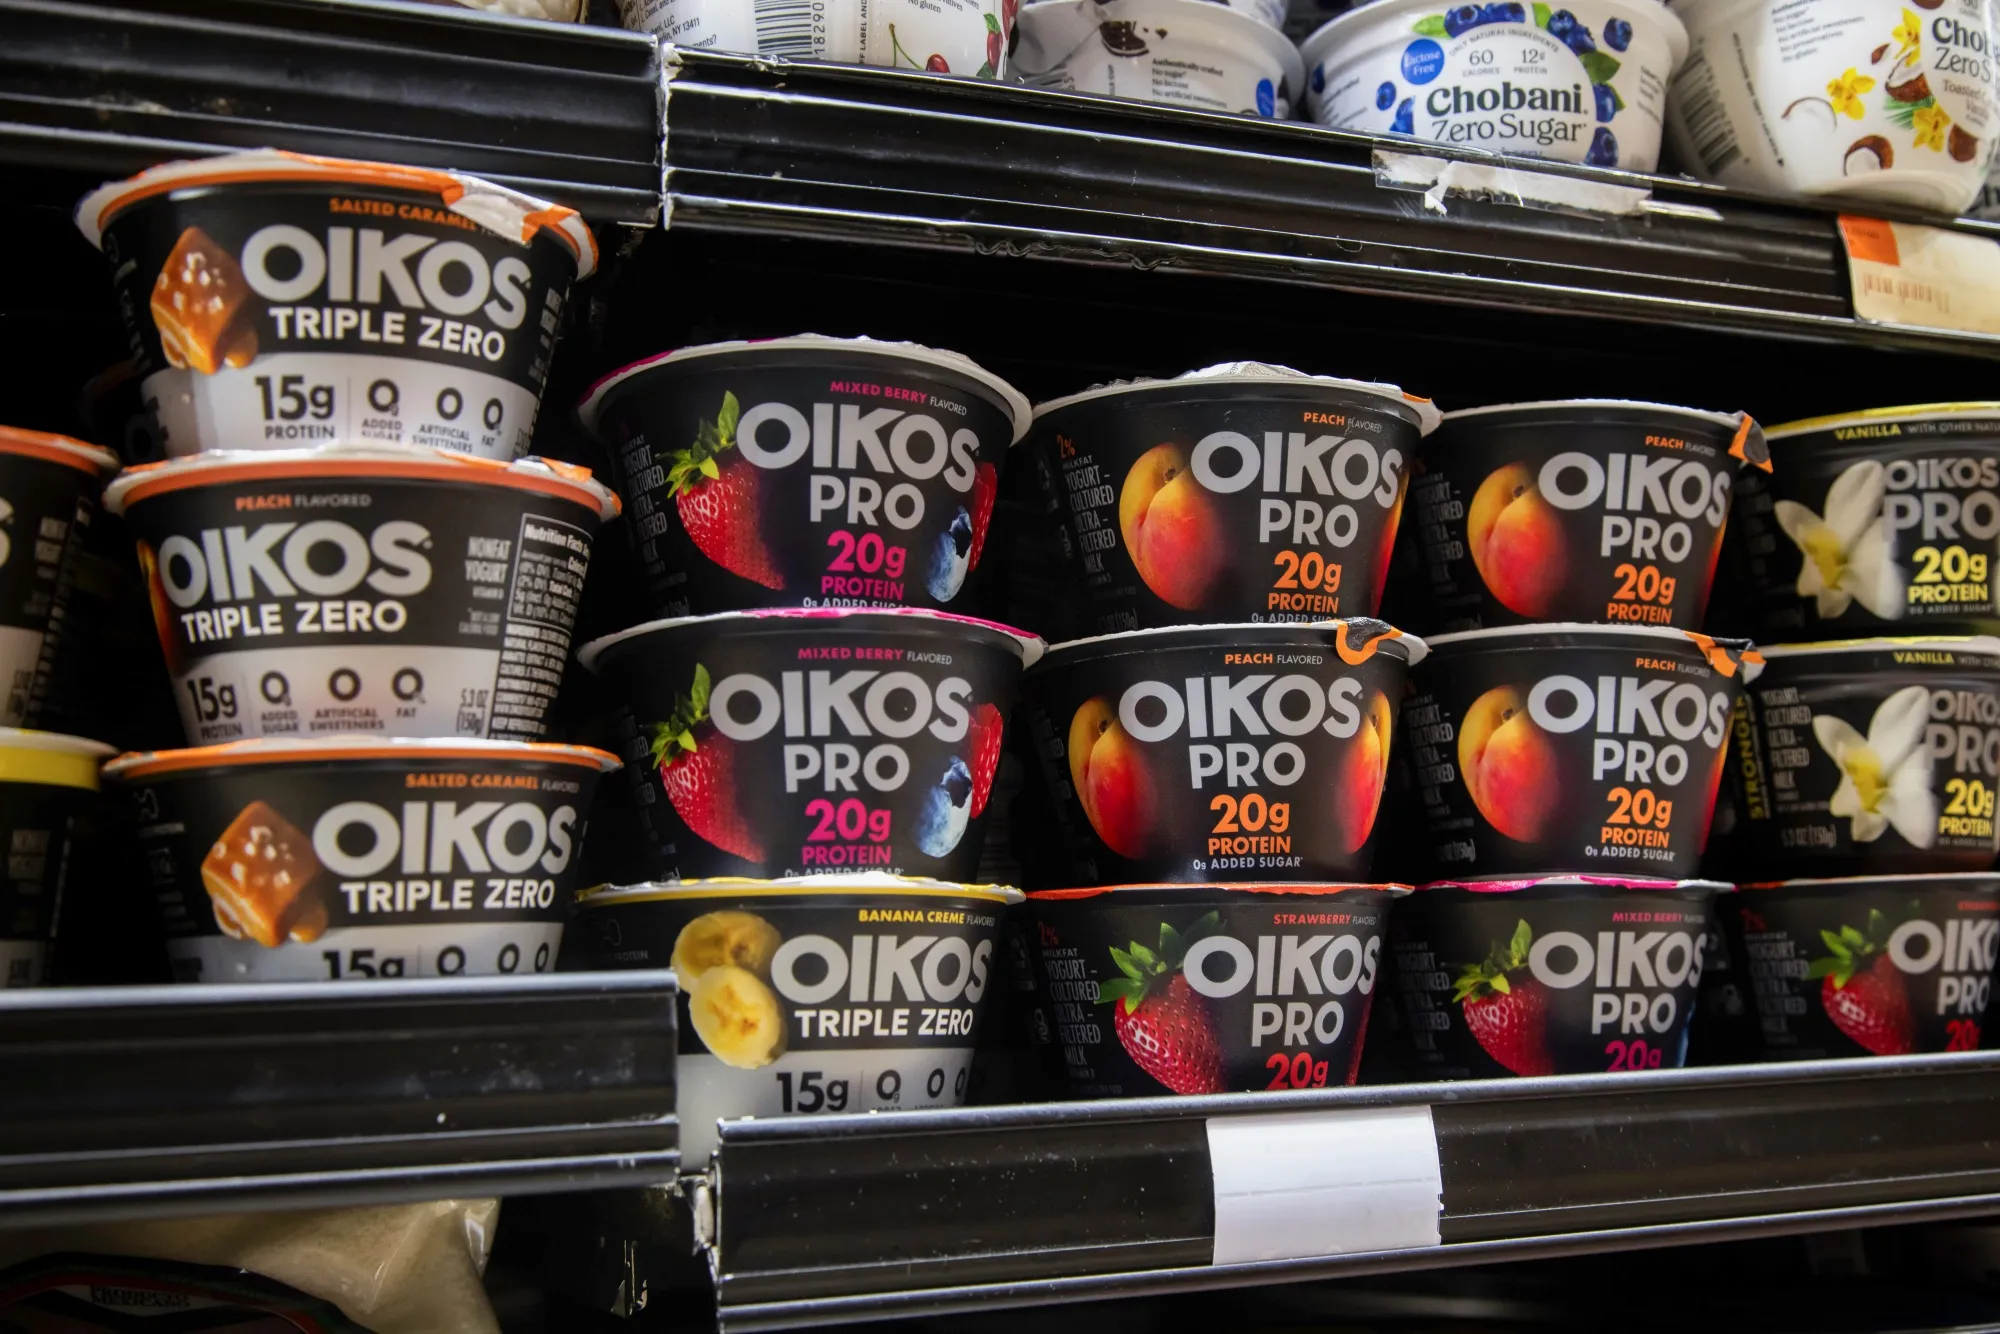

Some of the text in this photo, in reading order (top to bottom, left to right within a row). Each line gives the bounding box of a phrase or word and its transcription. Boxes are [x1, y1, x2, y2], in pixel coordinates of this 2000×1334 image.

[920, 1, 942, 14] gluten
[860, 22, 868, 51] LABEL
[1469, 28, 1505, 45] NATURAL
[1404, 49, 1441, 69] Lactose
[1412, 63, 1435, 77] Free
[1461, 65, 1548, 78] CALORIES PROTEIN
[1469, 48, 1494, 66] 60
[1934, 46, 1980, 78] Zero
[1426, 81, 1582, 118] Chobani
[1431, 113, 1583, 146] Zero Sugar
[329, 197, 477, 233] SALTED CARAMEL
[240, 223, 531, 332] OIKOS
[267, 307, 407, 344] TRIPLE
[416, 315, 506, 363] ZERO
[254, 374, 336, 422] 15g
[435, 386, 464, 421] 0
[829, 380, 968, 417] MIXED BERRY FLAVORED
[264, 418, 496, 448] PROTEIN ADDED ARTIFICIAL FAT
[1303, 411, 1382, 434] PEACH FLAVORED
[1834, 423, 1902, 441] VANILLA
[411, 434, 474, 454] SWEETENERS
[735, 402, 979, 493] OIKOS
[1056, 433, 1076, 459] 2%
[1645, 435, 1716, 457] PEACH FLAVORED
[1063, 464, 1100, 492] YOGURT
[1190, 430, 1403, 508] OIKOS
[1883, 457, 1999, 491] OIKOS
[235, 494, 372, 511] PEACH FLAVORED
[809, 473, 926, 531] PRO
[1069, 484, 1115, 513] CULTURED
[1538, 451, 1731, 528] OIKOS
[1074, 510, 1100, 533] ULTRA
[1259, 498, 1359, 548] PRO
[1882, 490, 2000, 541] PRO
[524, 523, 567, 547] Nutrition
[1078, 528, 1116, 554] FILTERED
[1600, 515, 1693, 564] PRO
[157, 520, 433, 609] OIKOS
[826, 529, 907, 578] 20g
[1912, 545, 1988, 584] 20g
[1272, 549, 1342, 594] 20g
[1612, 563, 1677, 606] 20g
[821, 575, 905, 602] PROTEIN
[1268, 592, 1340, 614] PROTEIN
[1908, 583, 1989, 604] PROTEIN
[180, 601, 408, 643] TRIPLE ZERO
[1268, 613, 1308, 623] ADDED
[1606, 602, 1672, 625] PROTEIN
[797, 647, 953, 666] MIXED BERRY FLAVORED
[1224, 653, 1323, 666] PEACH FLAVORED
[1635, 657, 1711, 678] PEACH FLAVORED
[1892, 651, 1955, 666] VANILLA
[187, 667, 362, 723] 15g 0
[709, 670, 973, 743] OIKOS
[1118, 674, 1362, 743] OIKOS
[200, 707, 417, 741] PROTEIN ADDED ARTIFICIAL FAT
[261, 720, 385, 734] SUGAR SWEETENERS
[1527, 675, 1729, 749] OIKOS
[1188, 742, 1306, 790] PRO
[1592, 739, 1689, 786] PRO
[1926, 723, 2000, 777] PRO
[405, 773, 539, 790] SALTED CARAMEL
[783, 743, 911, 794] PRO
[1209, 793, 1291, 835] 20g
[1605, 786, 1673, 829] 20g
[1944, 778, 1995, 818] 20g
[804, 798, 892, 844] 20g
[1939, 816, 1994, 837] PROTEIN
[312, 800, 576, 878] OIKOS
[1208, 835, 1292, 856] PROTEIN
[1585, 845, 1674, 861] 0g ADDED SUGAR
[1601, 826, 1670, 849] PROTEIN
[801, 845, 892, 866] PROTEIN
[1192, 856, 1301, 871] 0g ADDED SUGAR
[340, 879, 556, 915] TRIPLE ZERO
[858, 908, 965, 926] BANANA CREME
[1273, 913, 1351, 926] STRAWBERRY
[1612, 912, 1683, 923] MIXED BERRY
[321, 949, 406, 979] 15g
[770, 933, 992, 1005] OIKOS
[1044, 959, 1086, 980] YOGURT
[1183, 935, 1381, 999] OIKOS
[1528, 931, 1707, 989] OIKOS
[1049, 980, 1101, 1003] CULTURED
[1936, 976, 1991, 1016] PRO
[794, 1009, 974, 1038] TRIPLE ZERO
[1053, 1001, 1085, 1023] ULTRA
[1251, 1000, 1345, 1048] PRO
[1591, 993, 1677, 1034] PRO
[1060, 1023, 1101, 1045] FILTERED
[1265, 1052, 1329, 1090] 20g
[1604, 1040, 1662, 1073] 20g
[775, 1071, 850, 1114] 15g
[926, 1067, 945, 1099] 0
